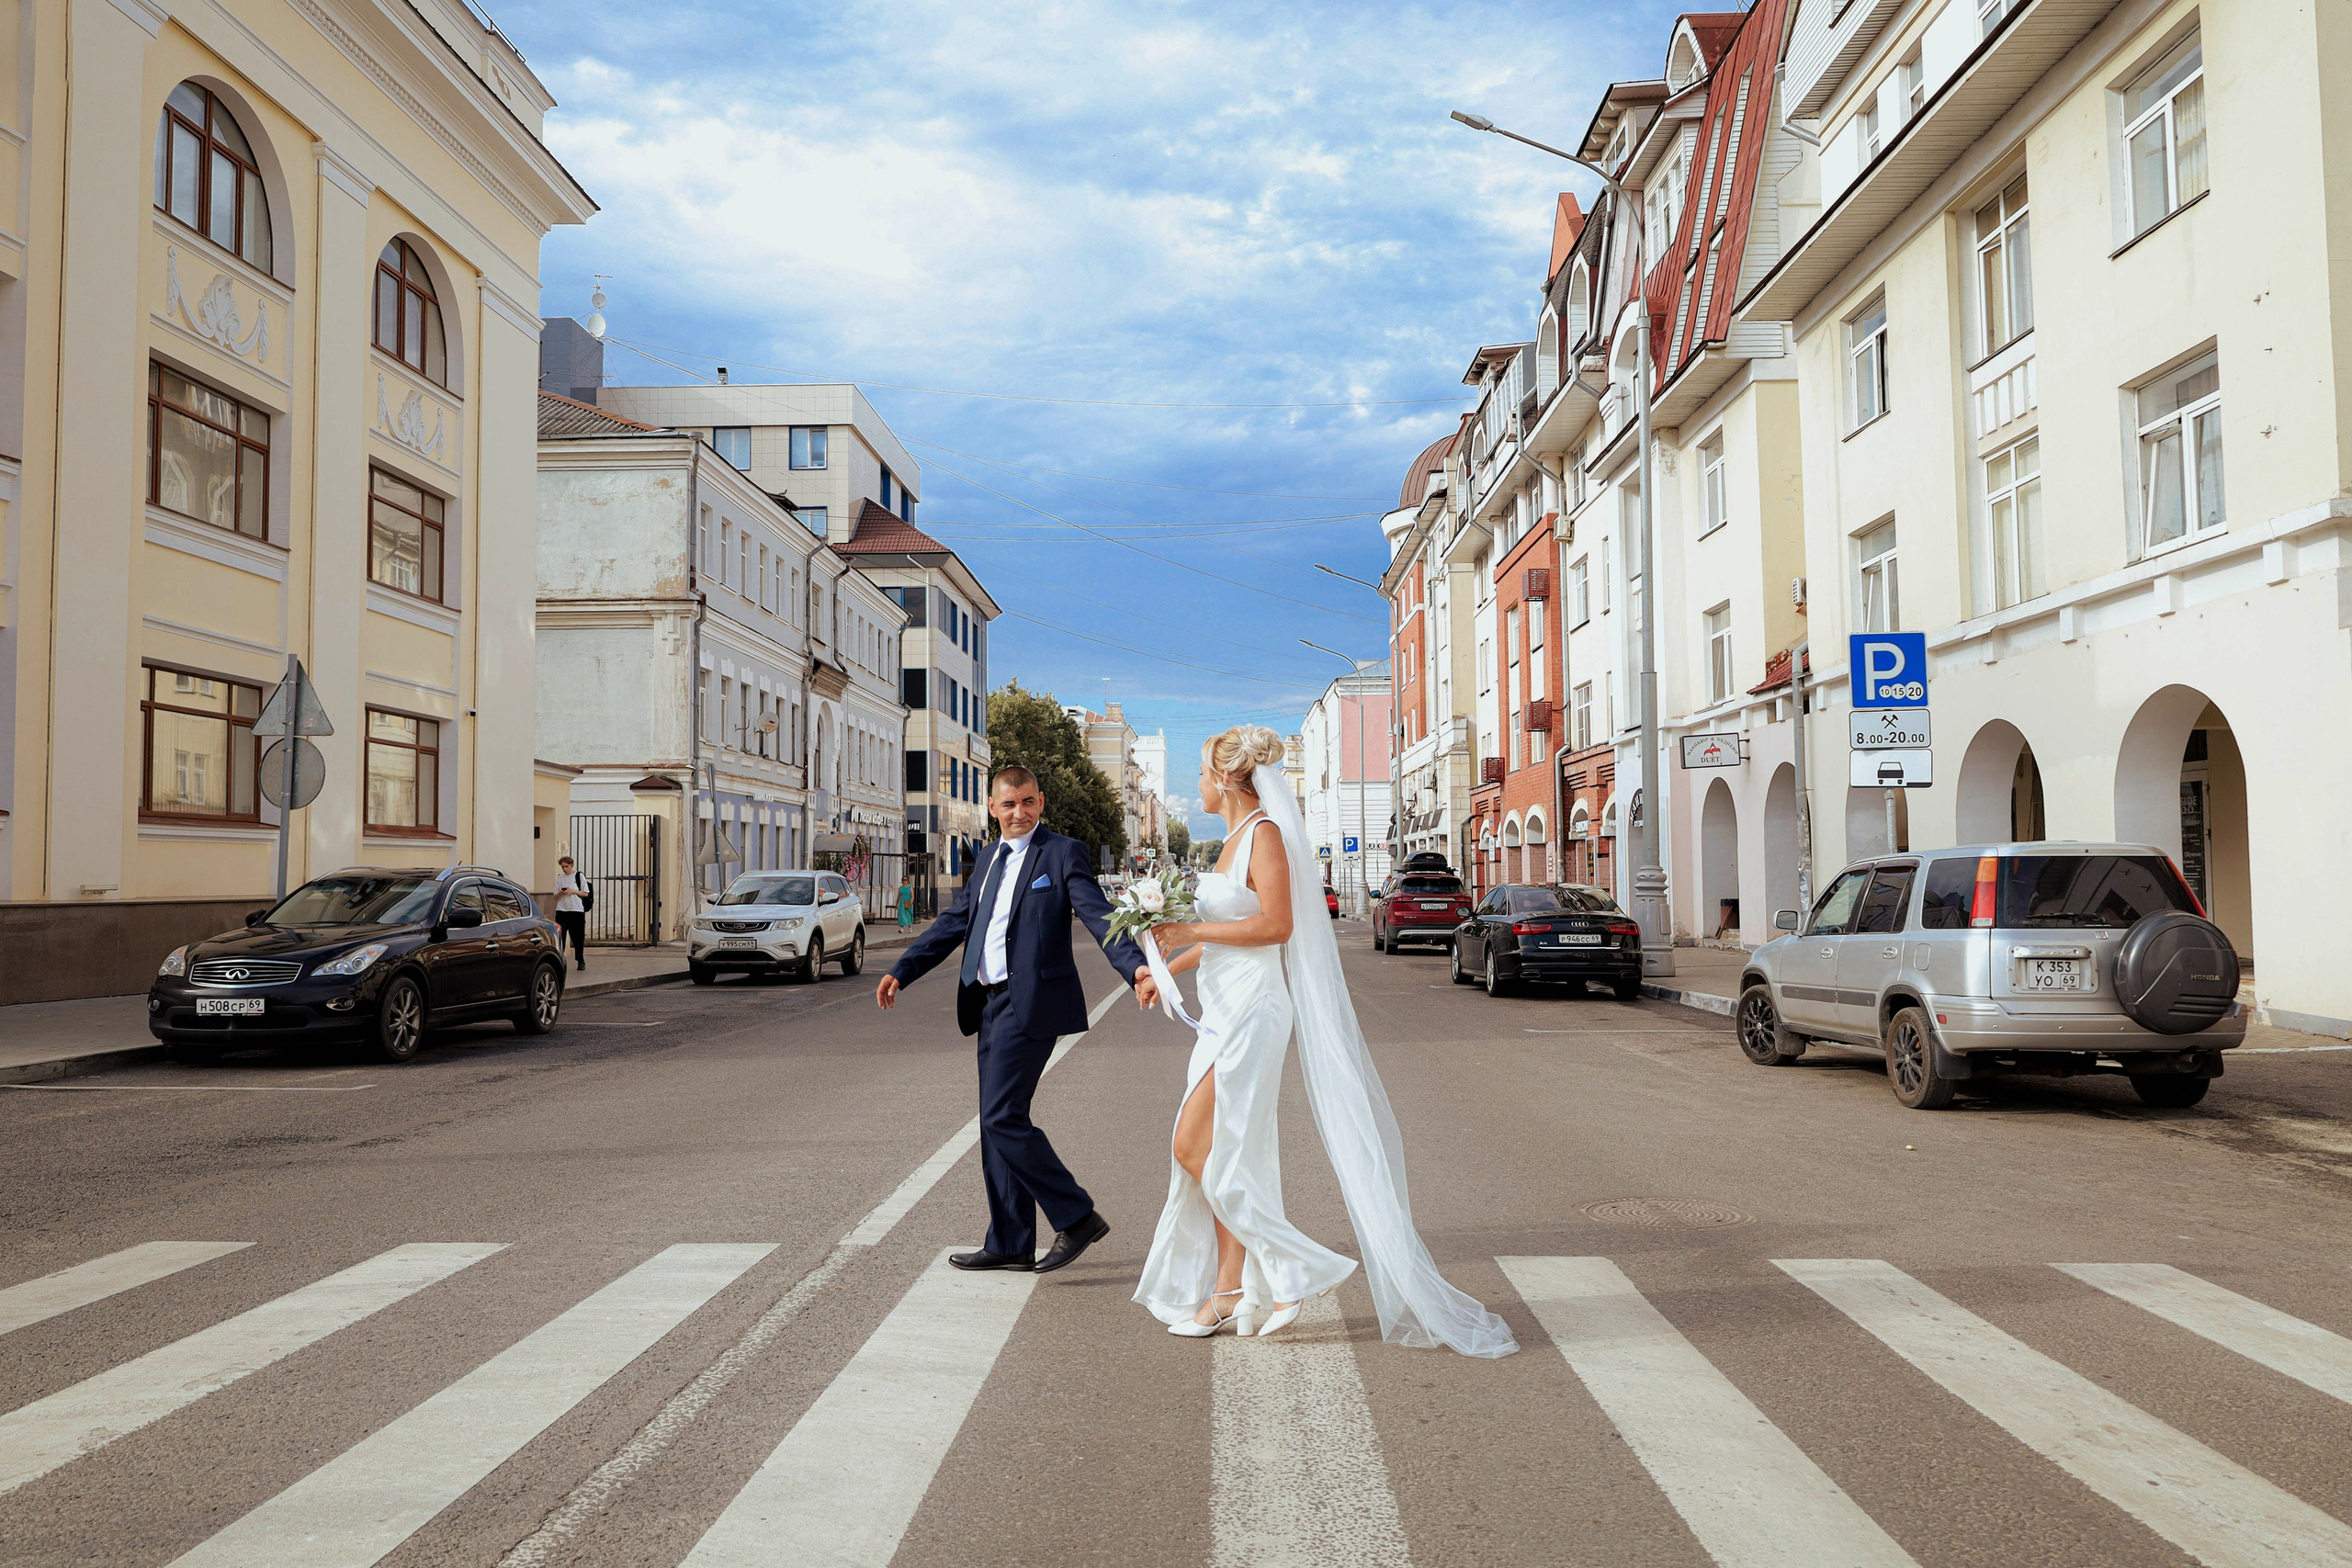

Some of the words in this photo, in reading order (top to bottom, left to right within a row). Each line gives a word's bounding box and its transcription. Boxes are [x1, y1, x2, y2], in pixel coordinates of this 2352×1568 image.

[1863, 642, 1905, 701] P
[1893, 687, 1905, 696] 15
[1907, 686, 1922, 697] 20
[1856, 731, 1925, 744] 8.00-20.00
[1345, 839, 1353, 851] P
[2037, 961, 2044, 972] К
[2049, 961, 2072, 972] 353
[2035, 976, 2053, 987] УО
[2063, 976, 2075, 985] 69
[200, 1000, 245, 1012] Н508СР
[249, 999, 261, 1009] 69
